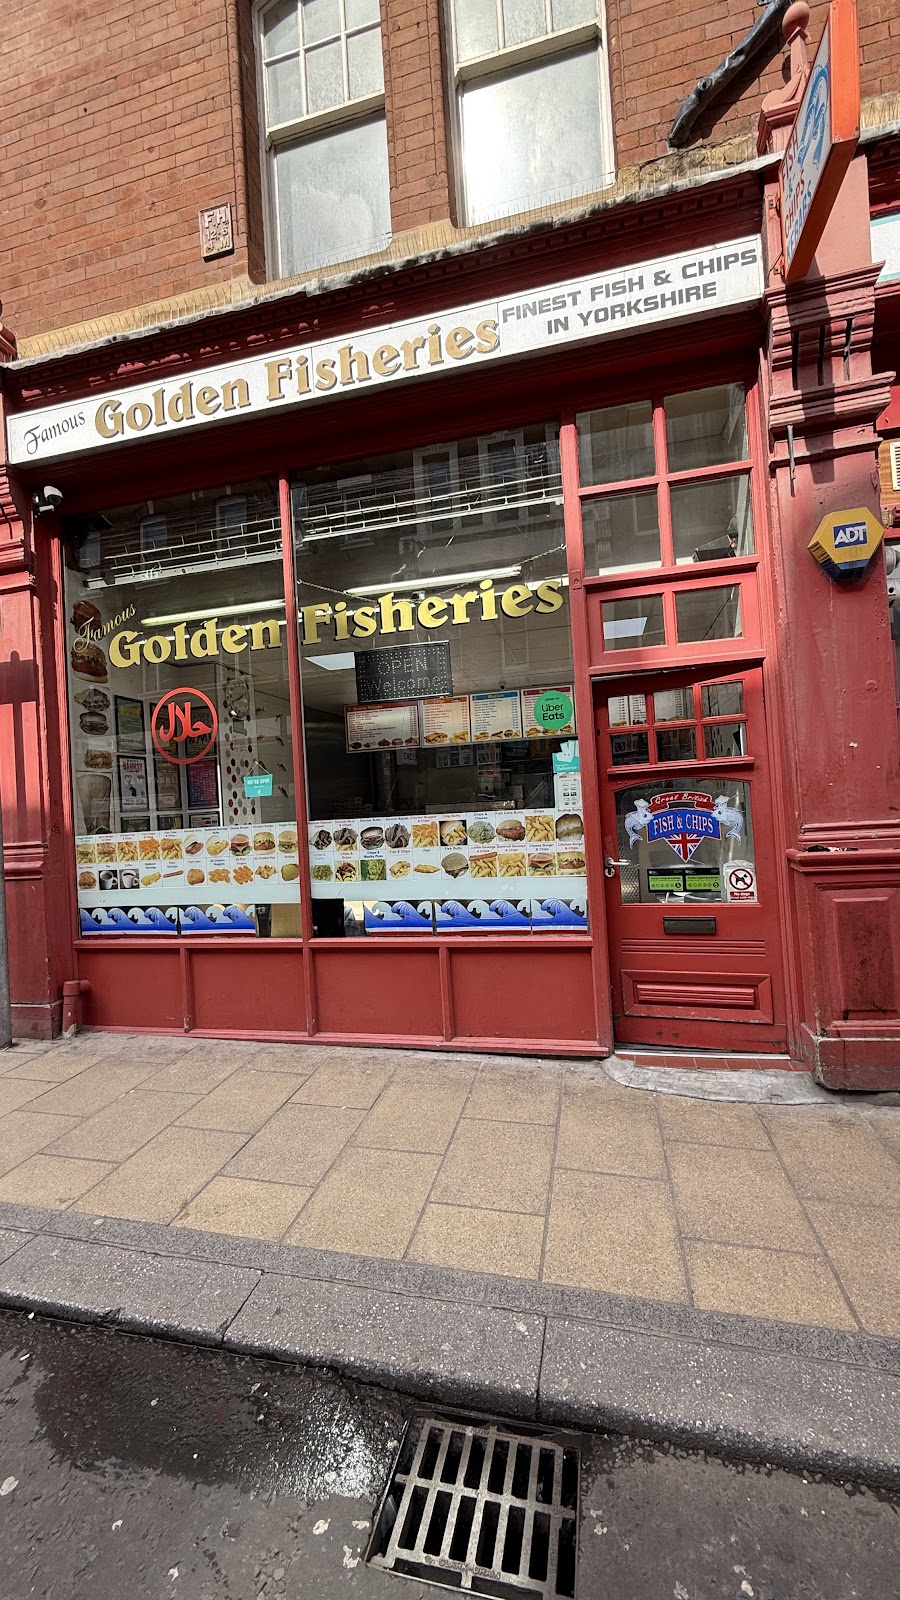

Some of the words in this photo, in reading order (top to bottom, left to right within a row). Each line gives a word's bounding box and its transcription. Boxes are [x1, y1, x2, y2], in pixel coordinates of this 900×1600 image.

[502, 290, 581, 324] FINEST
[590, 274, 644, 302] FISH
[653, 270, 672, 286] &
[681, 248, 758, 280] CHIPS
[547, 316, 569, 335] IN
[577, 281, 717, 327] YORKSHIRE
[23, 411, 86, 455] Famous
[94, 377, 252, 439] Golden
[264, 318, 501, 401] Fisheries
[834, 525, 867, 545] ADT
[73, 603, 137, 653] Famous
[108, 617, 283, 669] Golden
[300, 578, 564, 646] Fisheries
[378, 657, 428, 675] OPEN
[364, 676, 441, 693] Welcome
[541, 703, 564, 713] Uber
[542, 712, 565, 721] Eats
[160, 701, 212, 742] حلال
[122, 761, 143, 771] BANKSY
[655, 794, 680, 804] Great
[682, 793, 709, 803] British
[653, 815, 675, 835] FISH
[676, 814, 684, 829] &
[686, 814, 714, 833] CHIPS
